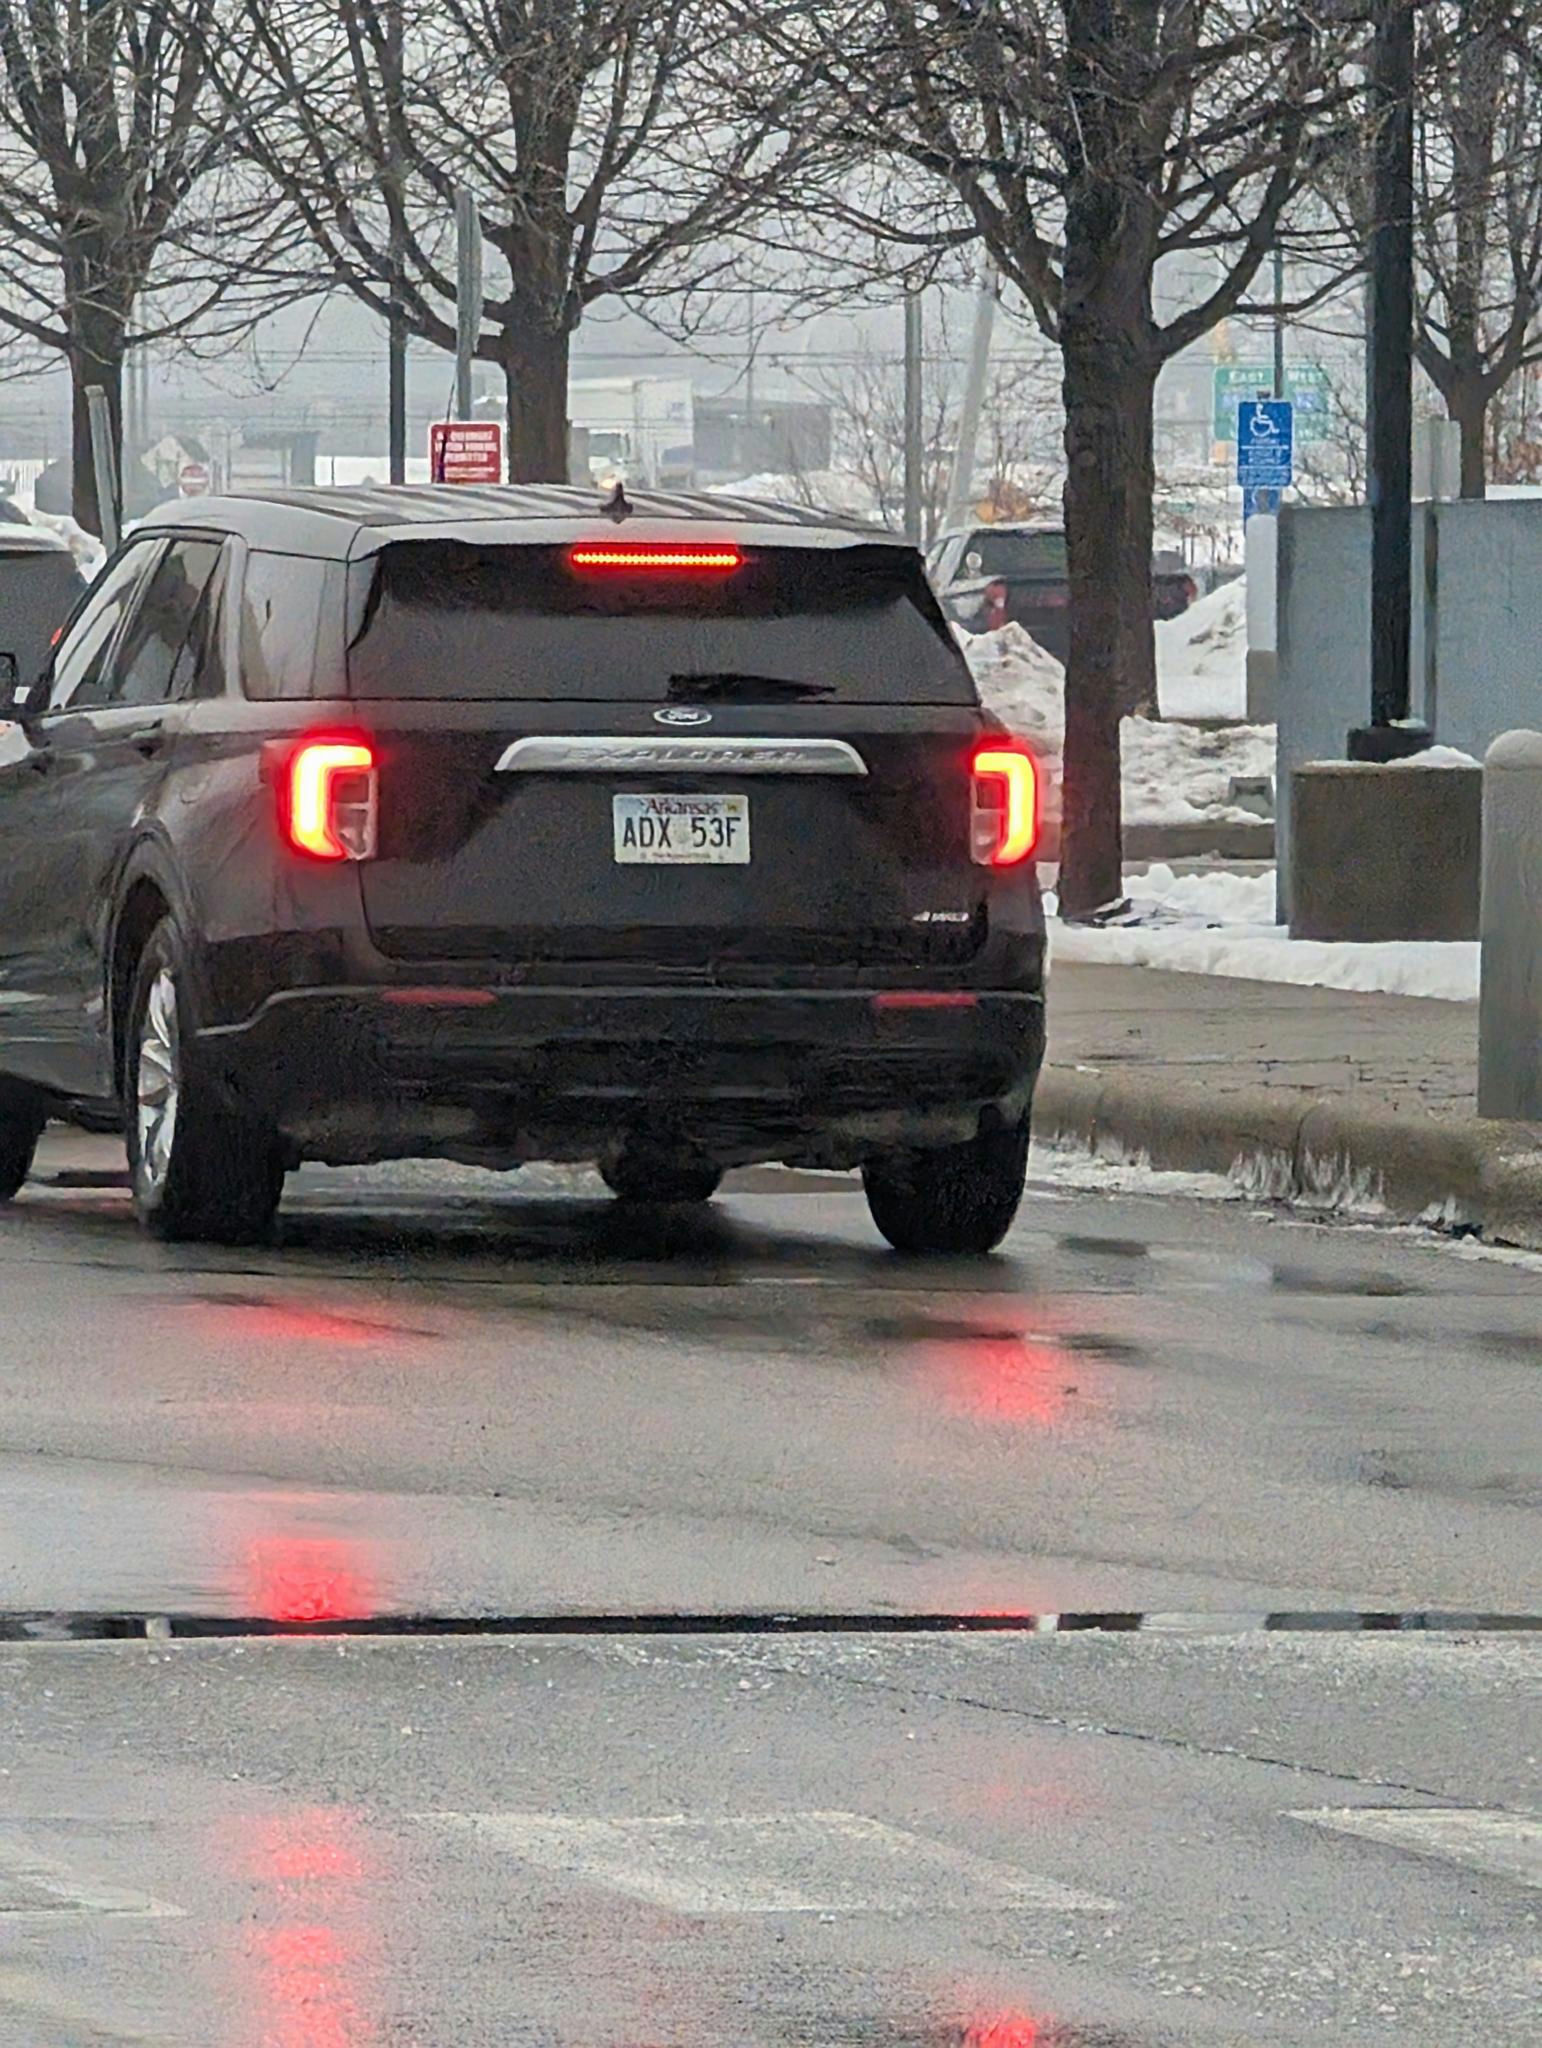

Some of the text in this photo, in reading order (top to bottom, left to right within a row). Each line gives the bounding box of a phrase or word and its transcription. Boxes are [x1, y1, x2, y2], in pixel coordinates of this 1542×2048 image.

[566, 749, 807, 764] EXPLORER
[645, 799, 721, 815] Arkansas
[623, 816, 741, 848] ADX 53F
